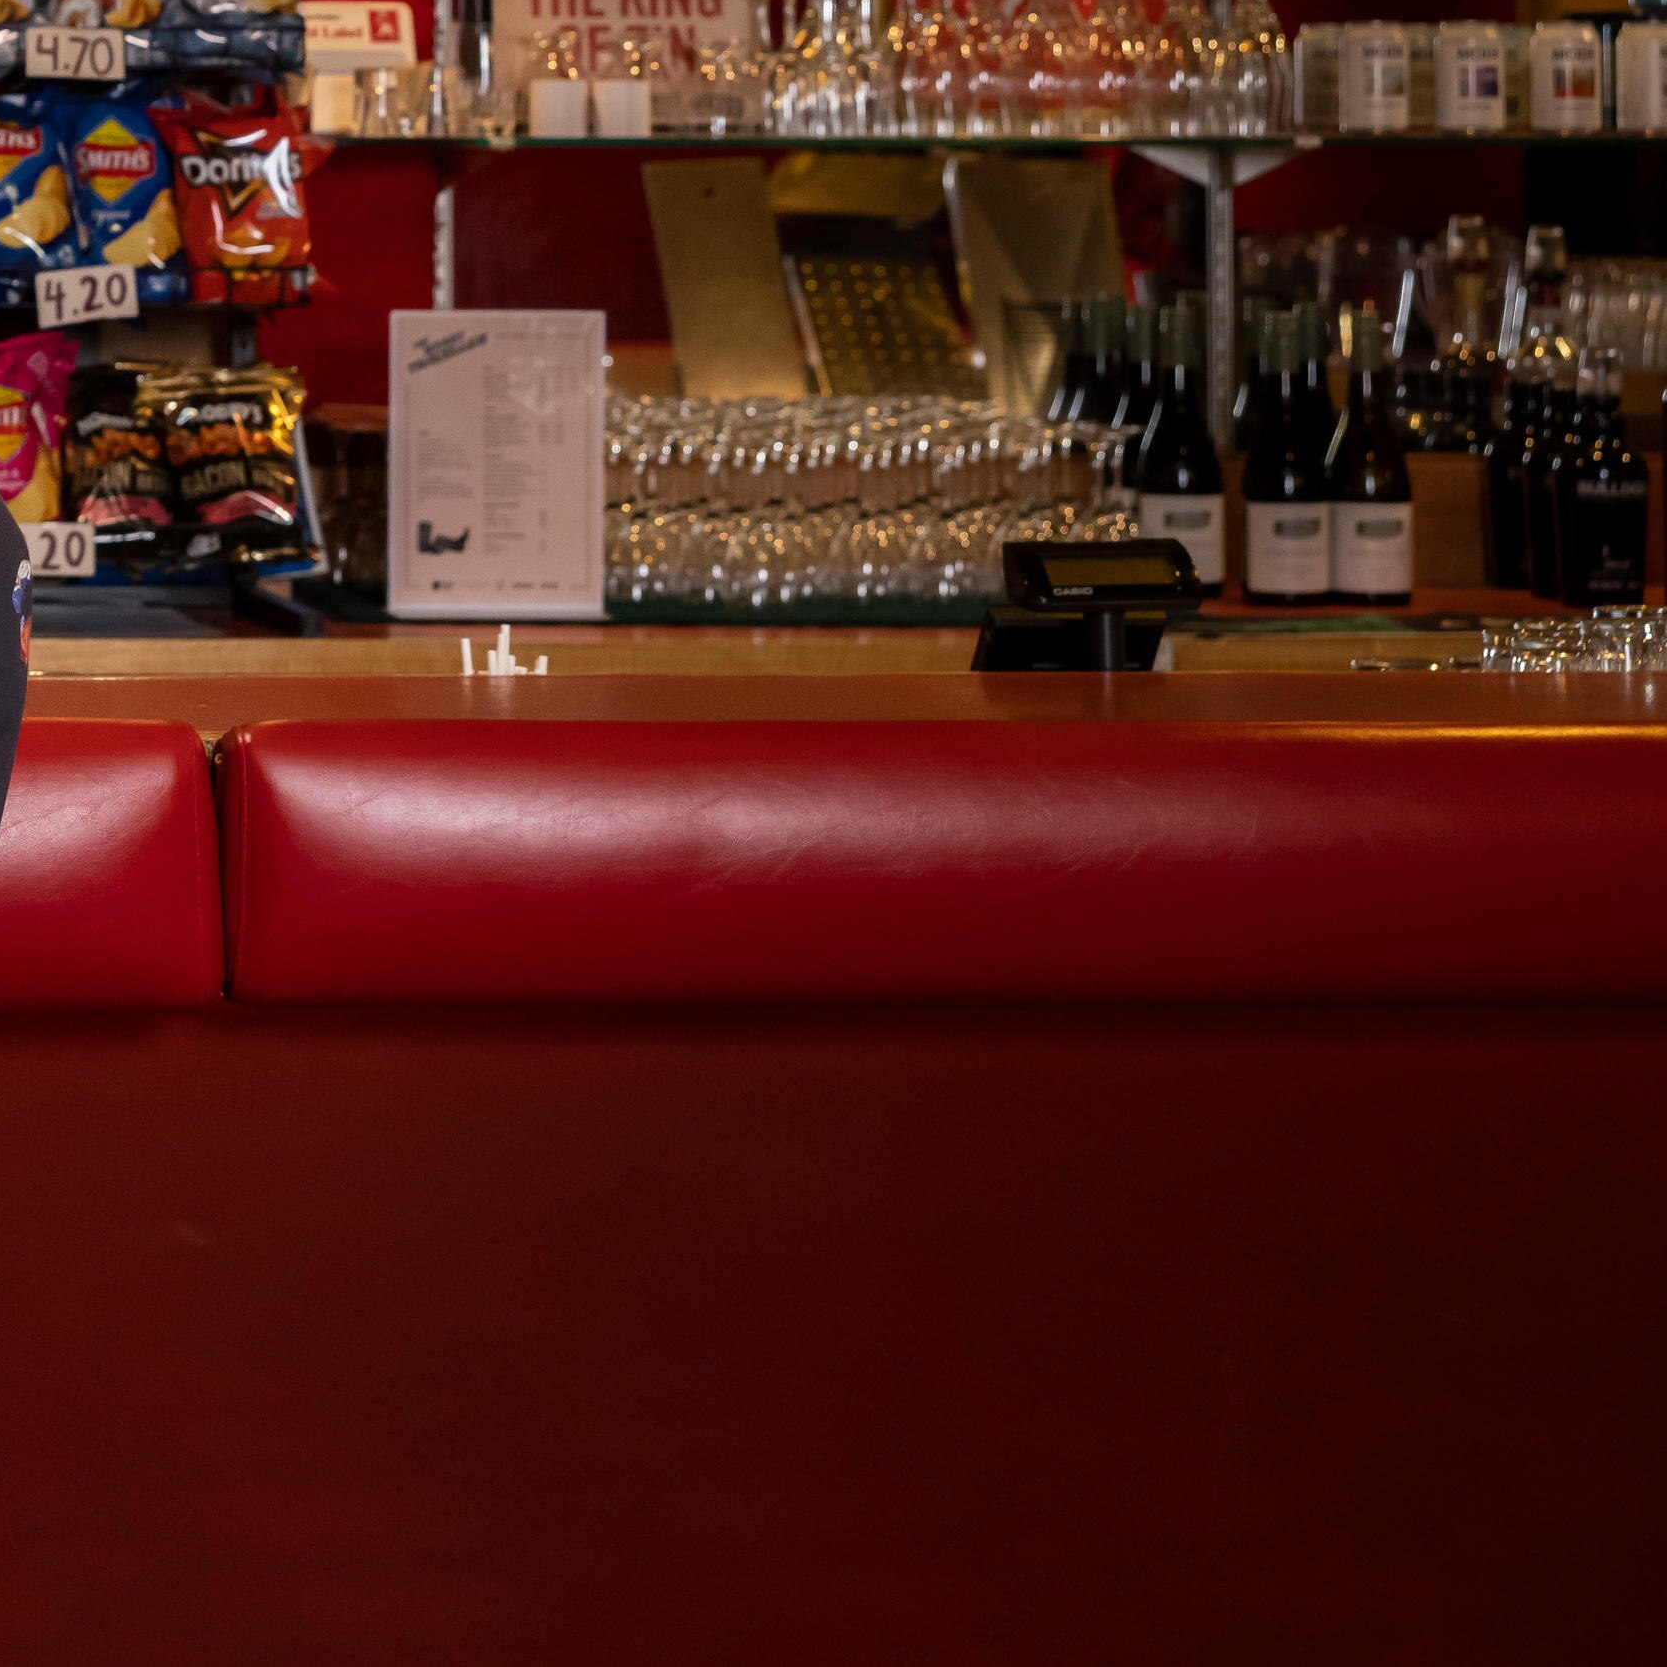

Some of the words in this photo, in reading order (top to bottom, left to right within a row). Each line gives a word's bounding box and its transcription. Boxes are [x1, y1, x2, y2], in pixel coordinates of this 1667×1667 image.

[34, 33, 115, 78] 4.70
[43, 272, 127, 321] 4.20
[31, 531, 86, 571] .20
[1053, 586, 1094, 597] CASIO
